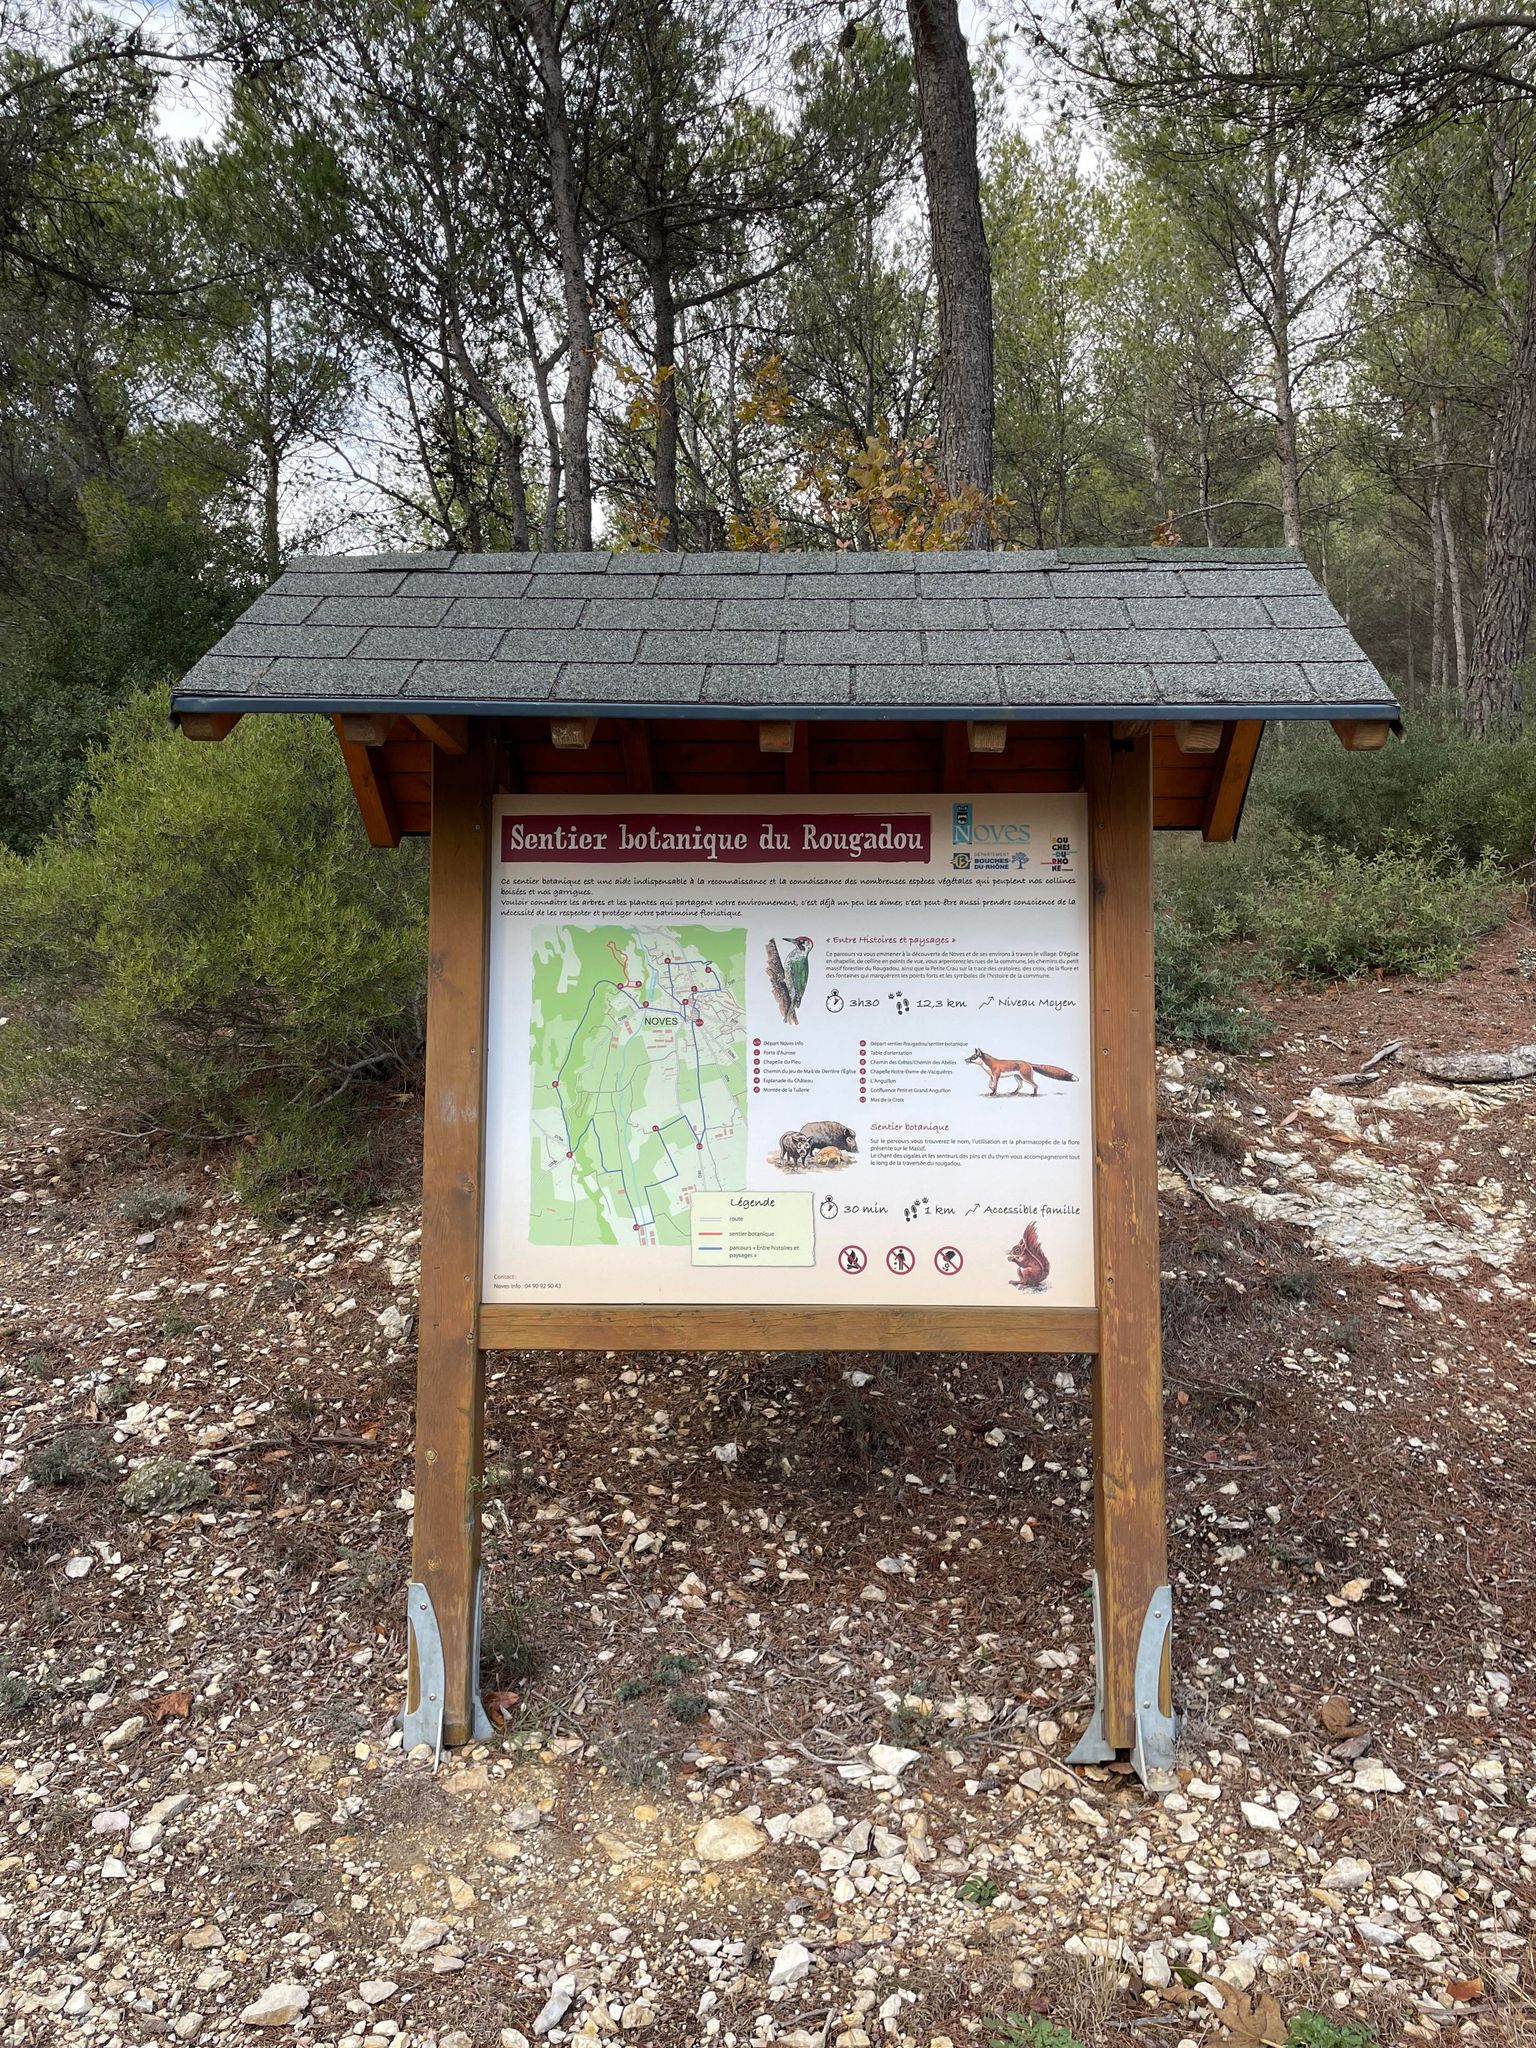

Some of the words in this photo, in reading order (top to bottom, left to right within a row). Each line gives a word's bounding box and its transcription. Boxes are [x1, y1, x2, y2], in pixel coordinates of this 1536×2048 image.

[953, 824, 1031, 845] Noves
[510, 824, 608, 850] Sentier
[618, 824, 748, 860] botanique
[759, 824, 791, 850] du
[802, 824, 924, 858] Rougadou
[512, 876, 540, 885] sentier
[542, 877, 581, 887] botanique
[633, 877, 687, 887] indispensable
[789, 877, 842, 885] connaissance
[909, 876, 935, 887] espèces
[937, 876, 973, 887] végétales
[975, 876, 990, 887] qui
[992, 877, 1026, 887] peuplent
[1045, 875, 1077, 886] collines
[500, 887, 527, 898] boisées
[553, 887, 593, 897] garrigues.
[582, 898, 605, 906] arbres
[629, 897, 657, 908] plantes
[659, 898, 673, 908] qui
[675, 898, 713, 908] partagent
[715, 897, 736, 906] notre
[737, 897, 799, 907] environnement,
[800, 897, 818, 906] c'est
[819, 898, 835, 908] déjà
[879, 897, 903, 907] aimer,
[905, 898, 922, 906] c'est
[982, 897, 1012, 908] prendre
[1013, 897, 1055, 906] conscience
[1068, 896, 1076, 905] la
[559, 910, 592, 918] respecter
[601, 909, 633, 918] protéger
[634, 908, 655, 918] notre
[655, 908, 698, 919] patrimoine
[699, 908, 743, 919] floristique.
[859, 935, 897, 944] Histoires
[908, 937, 949, 947] paysages
[849, 997, 880, 1007] 3h30
[916, 999, 943, 1009] 12,3
[947, 998, 967, 1008] km
[998, 996, 1035, 1007] Niveau
[1038, 999, 1076, 1012] Moyen
[644, 1017, 678, 1026] NOVES
[870, 1122, 903, 1131] Sentier
[905, 1122, 949, 1134] botanique
[730, 1197, 775, 1210] Légende
[843, 1205, 860, 1214] 30
[863, 1202, 889, 1214] min
[935, 1205, 956, 1215] km
[983, 1204, 1038, 1215] Accessible
[1040, 1204, 1080, 1218] famille
